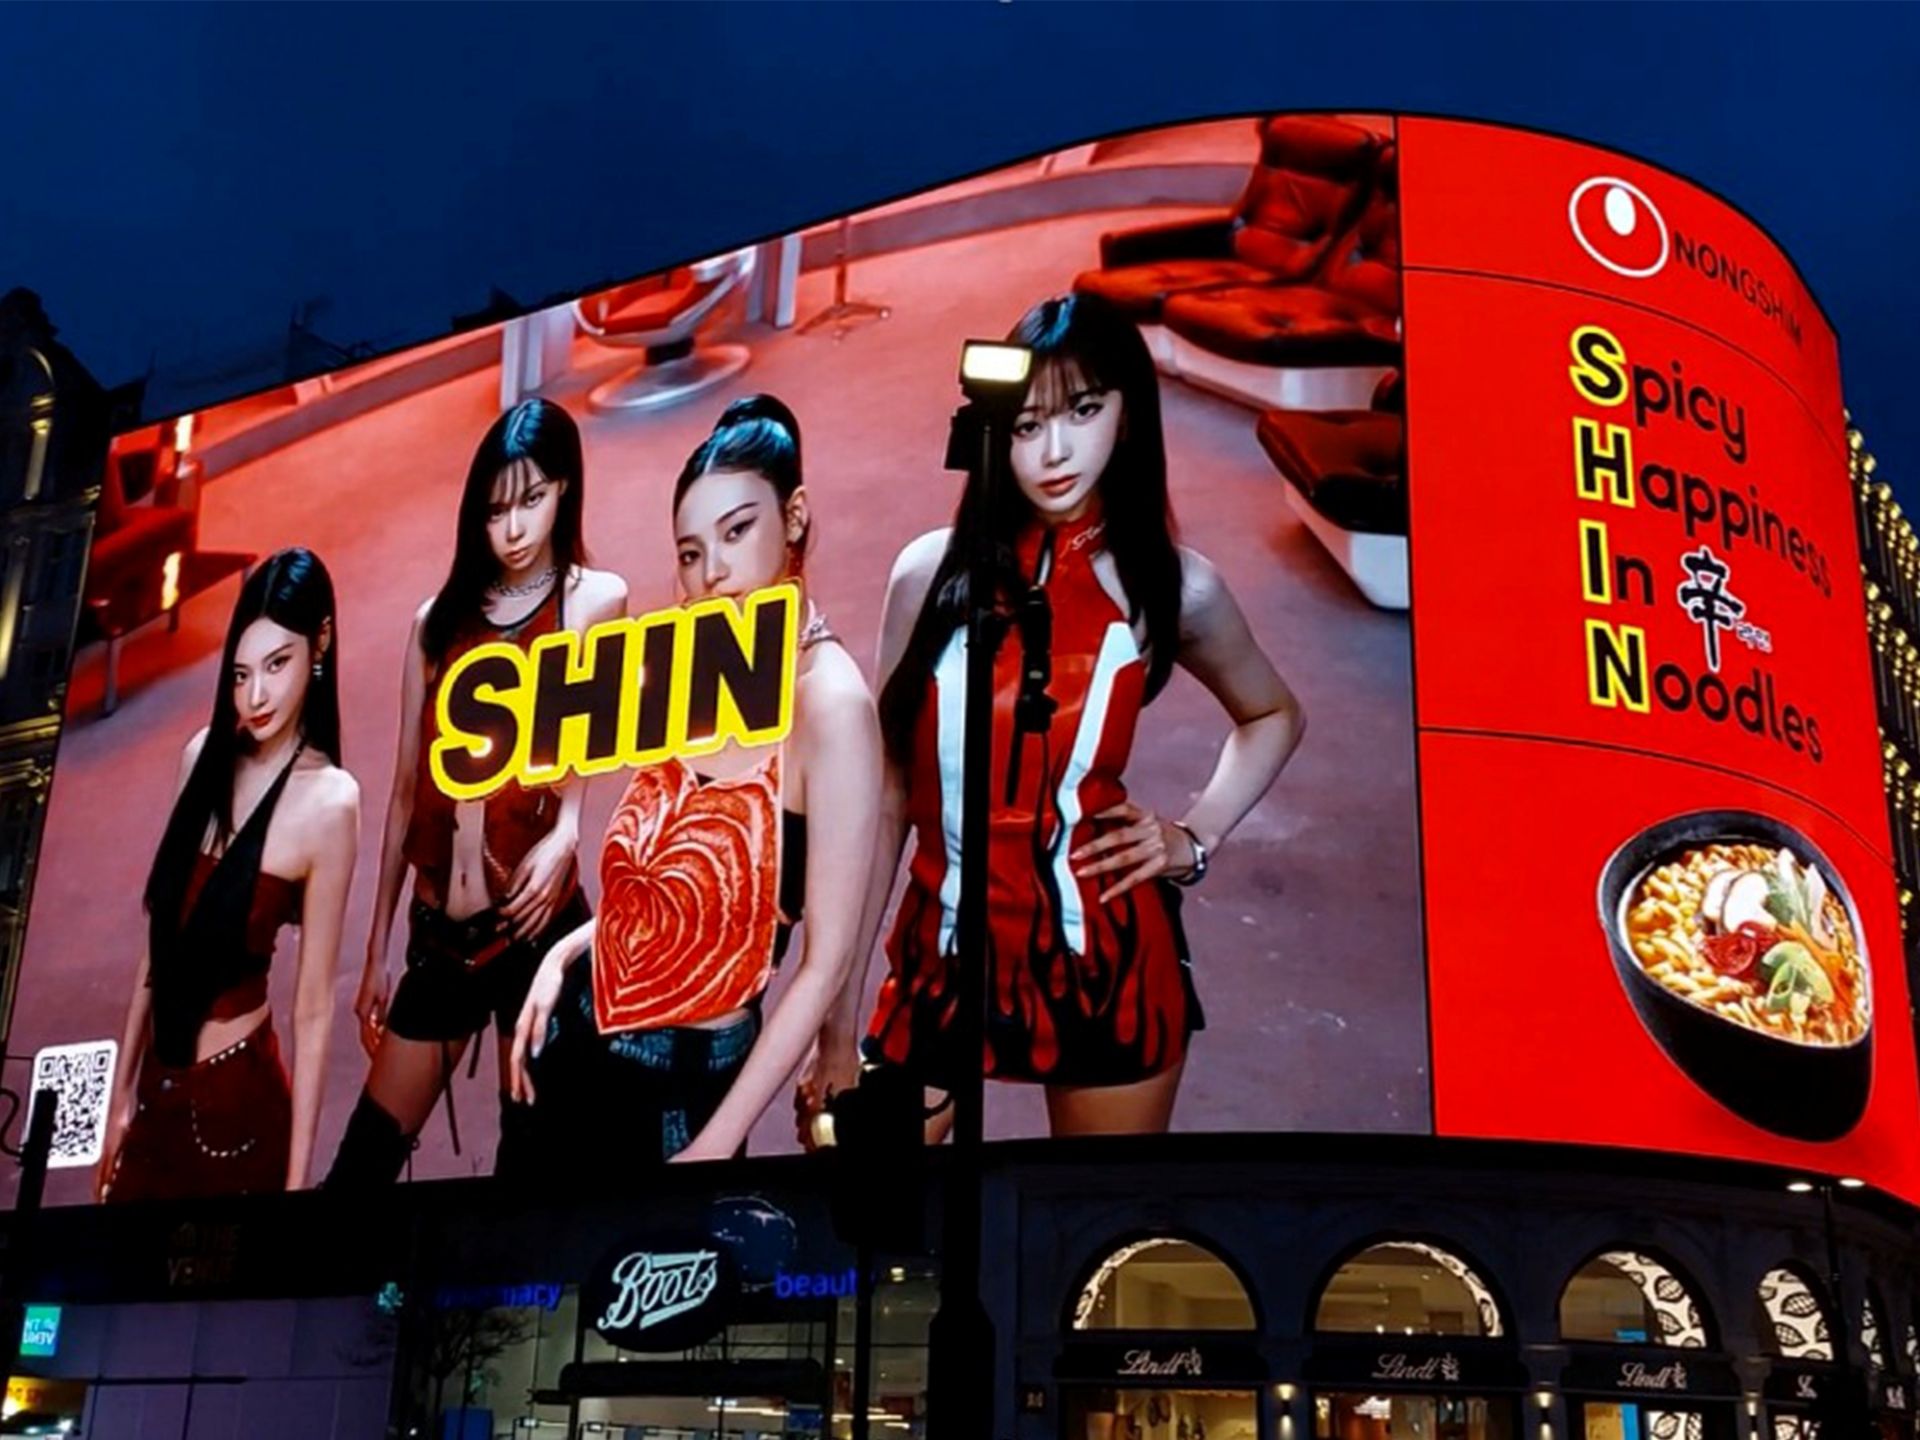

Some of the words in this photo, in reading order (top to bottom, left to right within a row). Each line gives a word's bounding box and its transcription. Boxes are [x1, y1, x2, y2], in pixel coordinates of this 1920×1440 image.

[1674, 229, 1802, 348] NONGSHIM
[1568, 325, 1747, 464] Spicy
[1572, 416, 1832, 598] Happiness
[1578, 518, 1655, 606] In
[1677, 545, 1745, 673] 辛
[430, 584, 799, 799] SHIN
[1584, 619, 1823, 763] Noodles
[595, 1249, 719, 1331] Boots
[774, 1262, 862, 1300] beaut
[1116, 1348, 1185, 1376] Lindt
[1371, 1352, 1442, 1381] Lindt
[1616, 1360, 1675, 1389] Lindt
